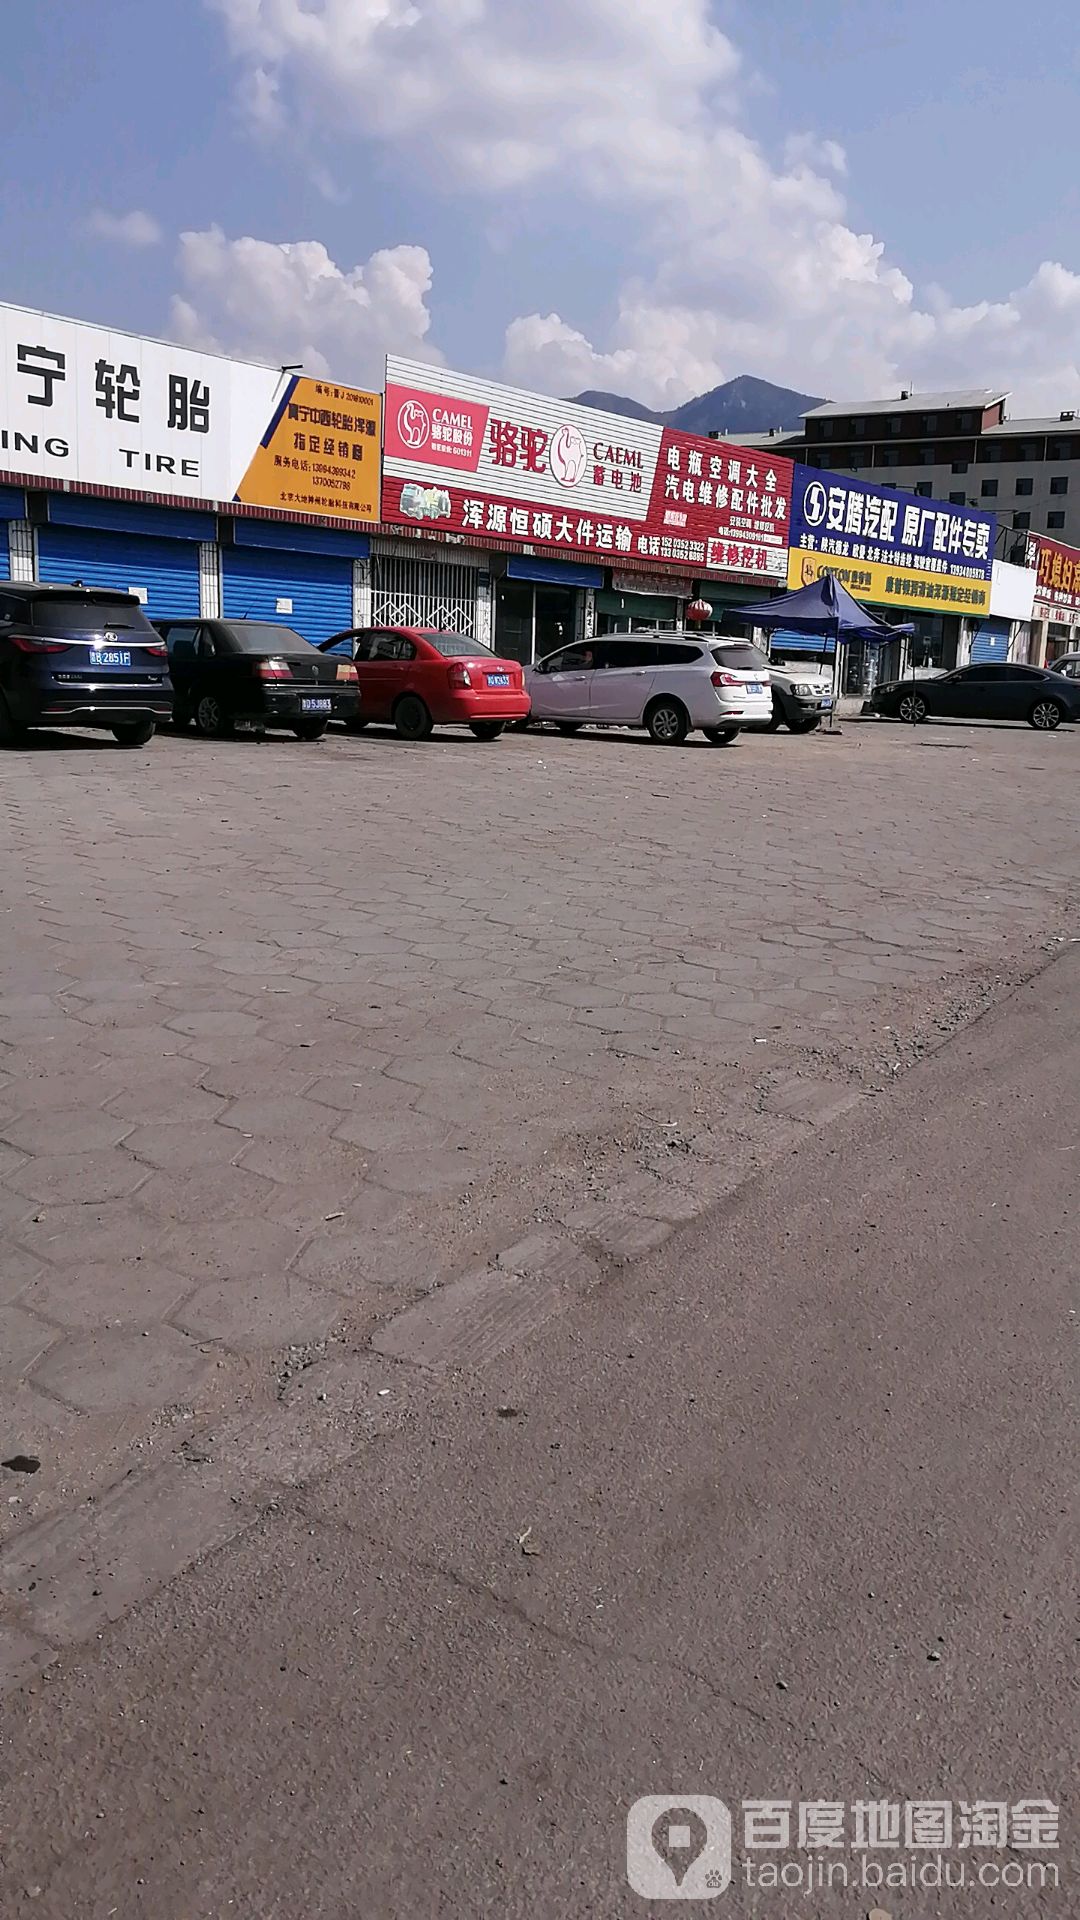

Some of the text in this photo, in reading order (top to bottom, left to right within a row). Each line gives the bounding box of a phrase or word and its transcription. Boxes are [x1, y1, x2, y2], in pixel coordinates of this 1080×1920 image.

[17, 344, 210, 434] 宁轮胎
[431, 425, 473, 447] 骆驼股份
[432, 408, 473, 429] CAMEL
[119, 448, 200, 478] TIRE
[489, 418, 548, 473] 骆驼
[593, 442, 644, 469] CAEML
[593, 464, 642, 493] 蓄电池
[667, 445, 777, 493] 电瓶空调大全
[665, 474, 787, 520] 汽电维修配件批发
[461, 499, 633, 552] 浑源恒硕大件运输
[637, 535, 661, 556] 电话
[826, 486, 899, 542] 安腾汽配
[901, 504, 991, 560] 原厂配件专卖
[710, 541, 768, 570] 维修挖机
